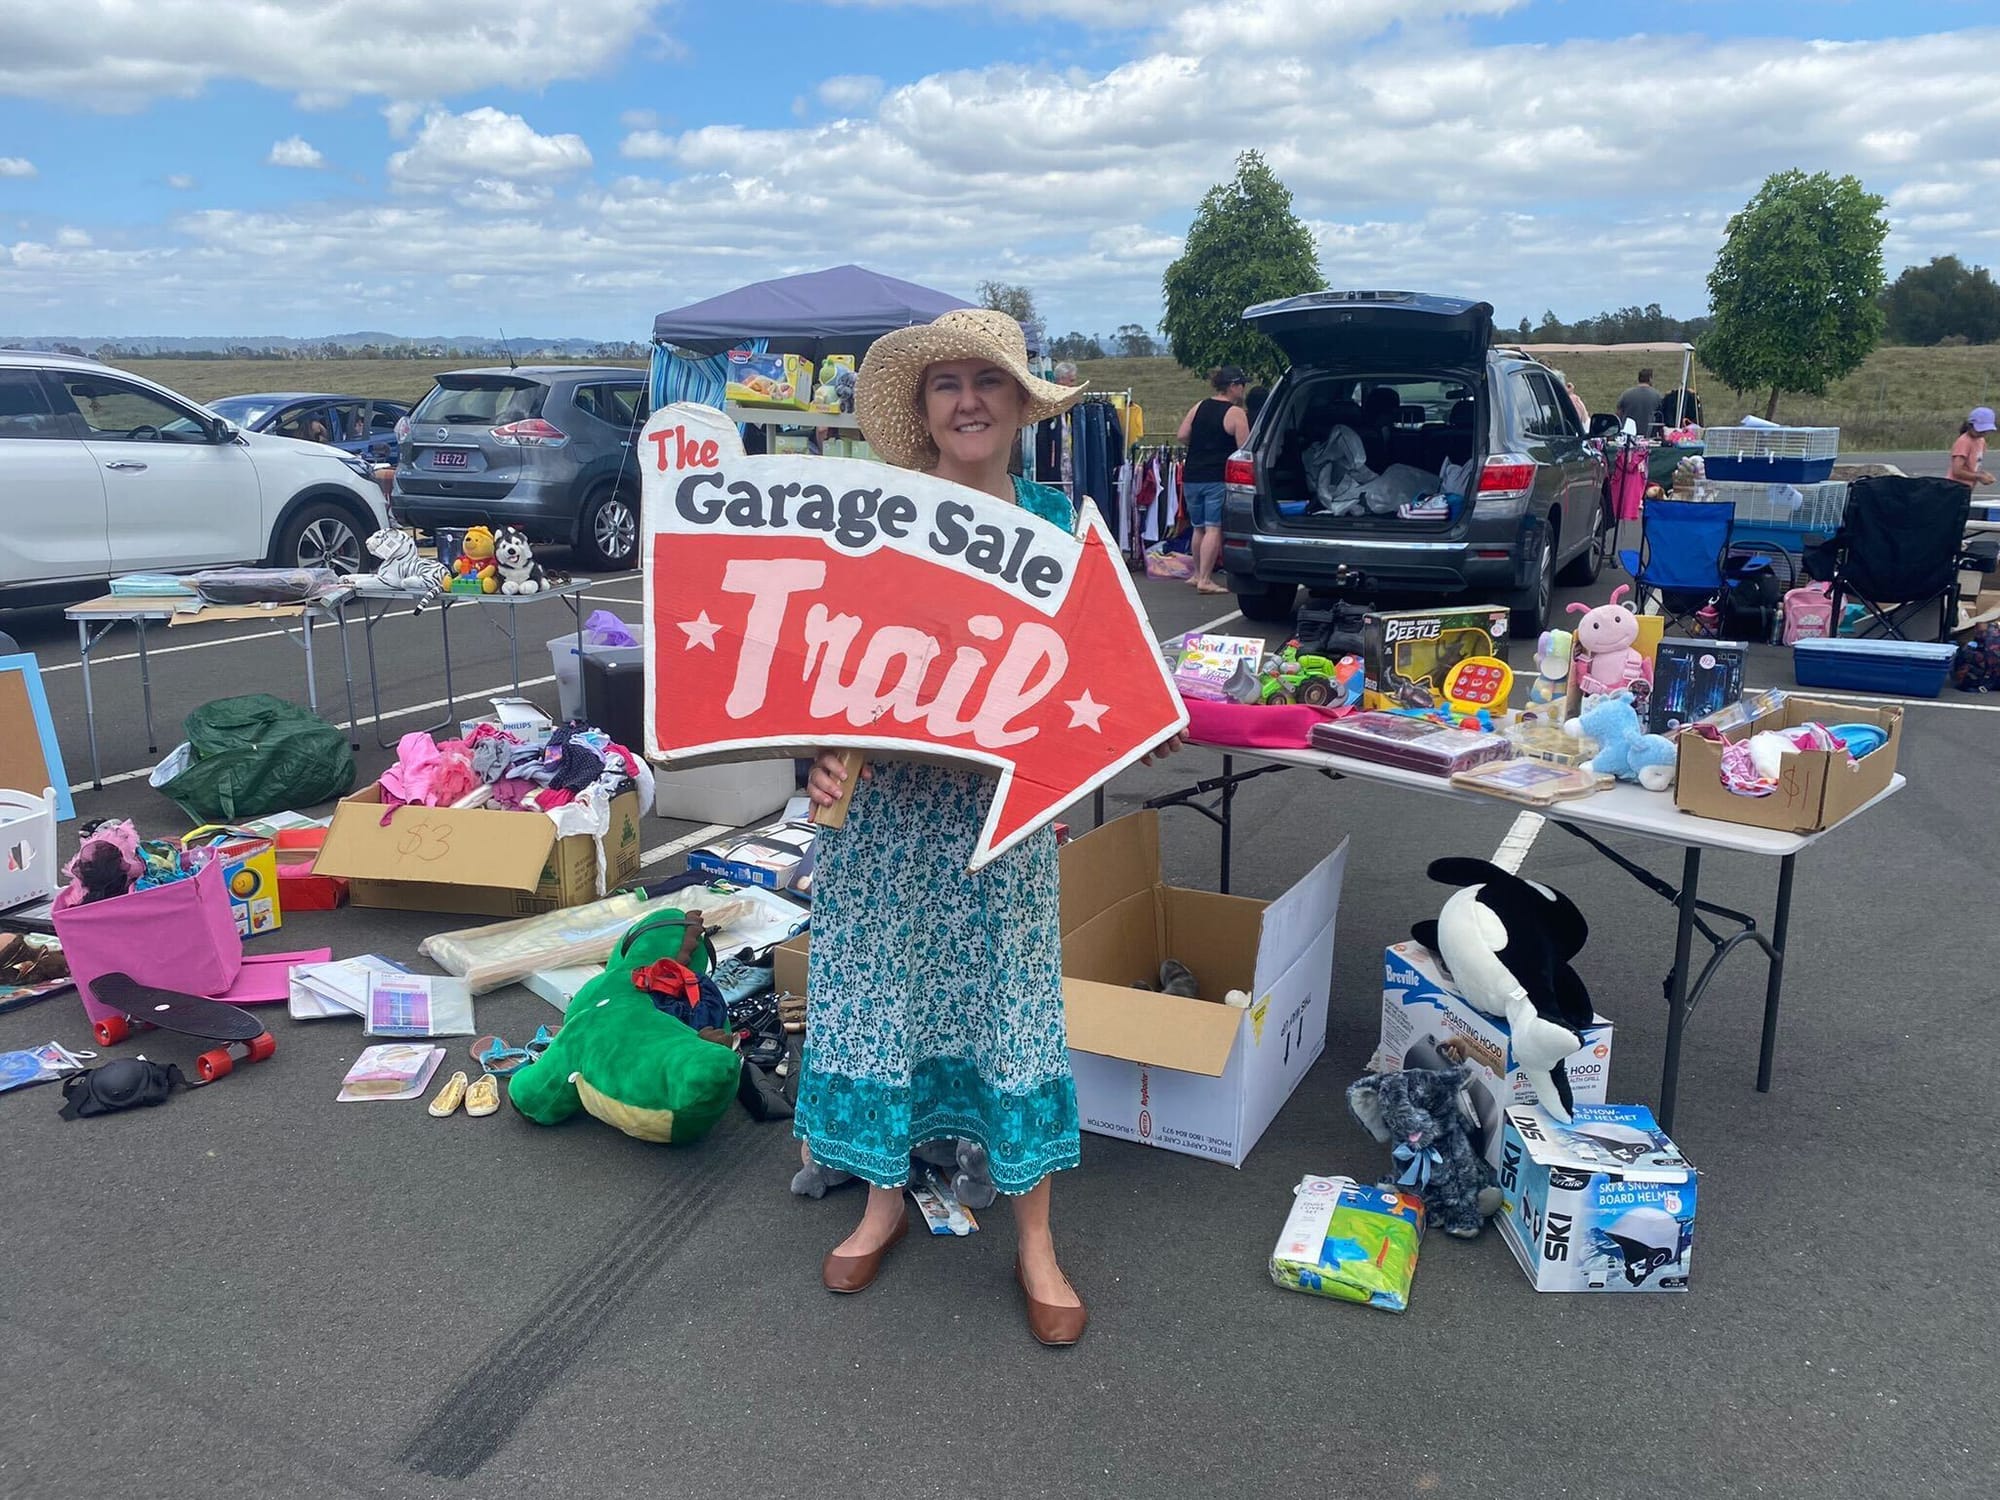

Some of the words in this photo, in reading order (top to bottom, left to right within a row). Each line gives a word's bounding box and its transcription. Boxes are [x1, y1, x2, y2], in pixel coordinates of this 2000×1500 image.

[648, 426, 720, 471] The
[676, 472, 917, 547] Garage
[928, 500, 1063, 598] Sale
[1385, 620, 1440, 642] BEETLE
[721, 559, 1069, 748] Trail
[1187, 639, 1225, 653] Sand
[1226, 643, 1258, 656] Arts
[503, 721, 532, 730] PHILIPS
[1782, 764, 1811, 811] $1
[397, 819, 453, 862] $3
[1385, 965, 1420, 987] Breville
[1442, 1006, 1480, 1041] ROASTING
[1479, 1034, 1503, 1058] HOOD
[1570, 1064, 1601, 1075] HOOD
[1087, 1118, 1115, 1130] DOCTOR
[1162, 1125, 1174, 1134] 973
[1514, 1115, 1547, 1142] SKI
[1181, 1138, 1208, 1152] CARPET
[1188, 1131, 1205, 1142] 1800
[1208, 1145, 1233, 1157] BRITEX
[1501, 1141, 1522, 1193] SKI
[1599, 1183, 1616, 1194] SKI
[1599, 1194, 1635, 1206] BOARD
[1638, 1190, 1681, 1203] HELMET
[1543, 1211, 1573, 1262] SKI
